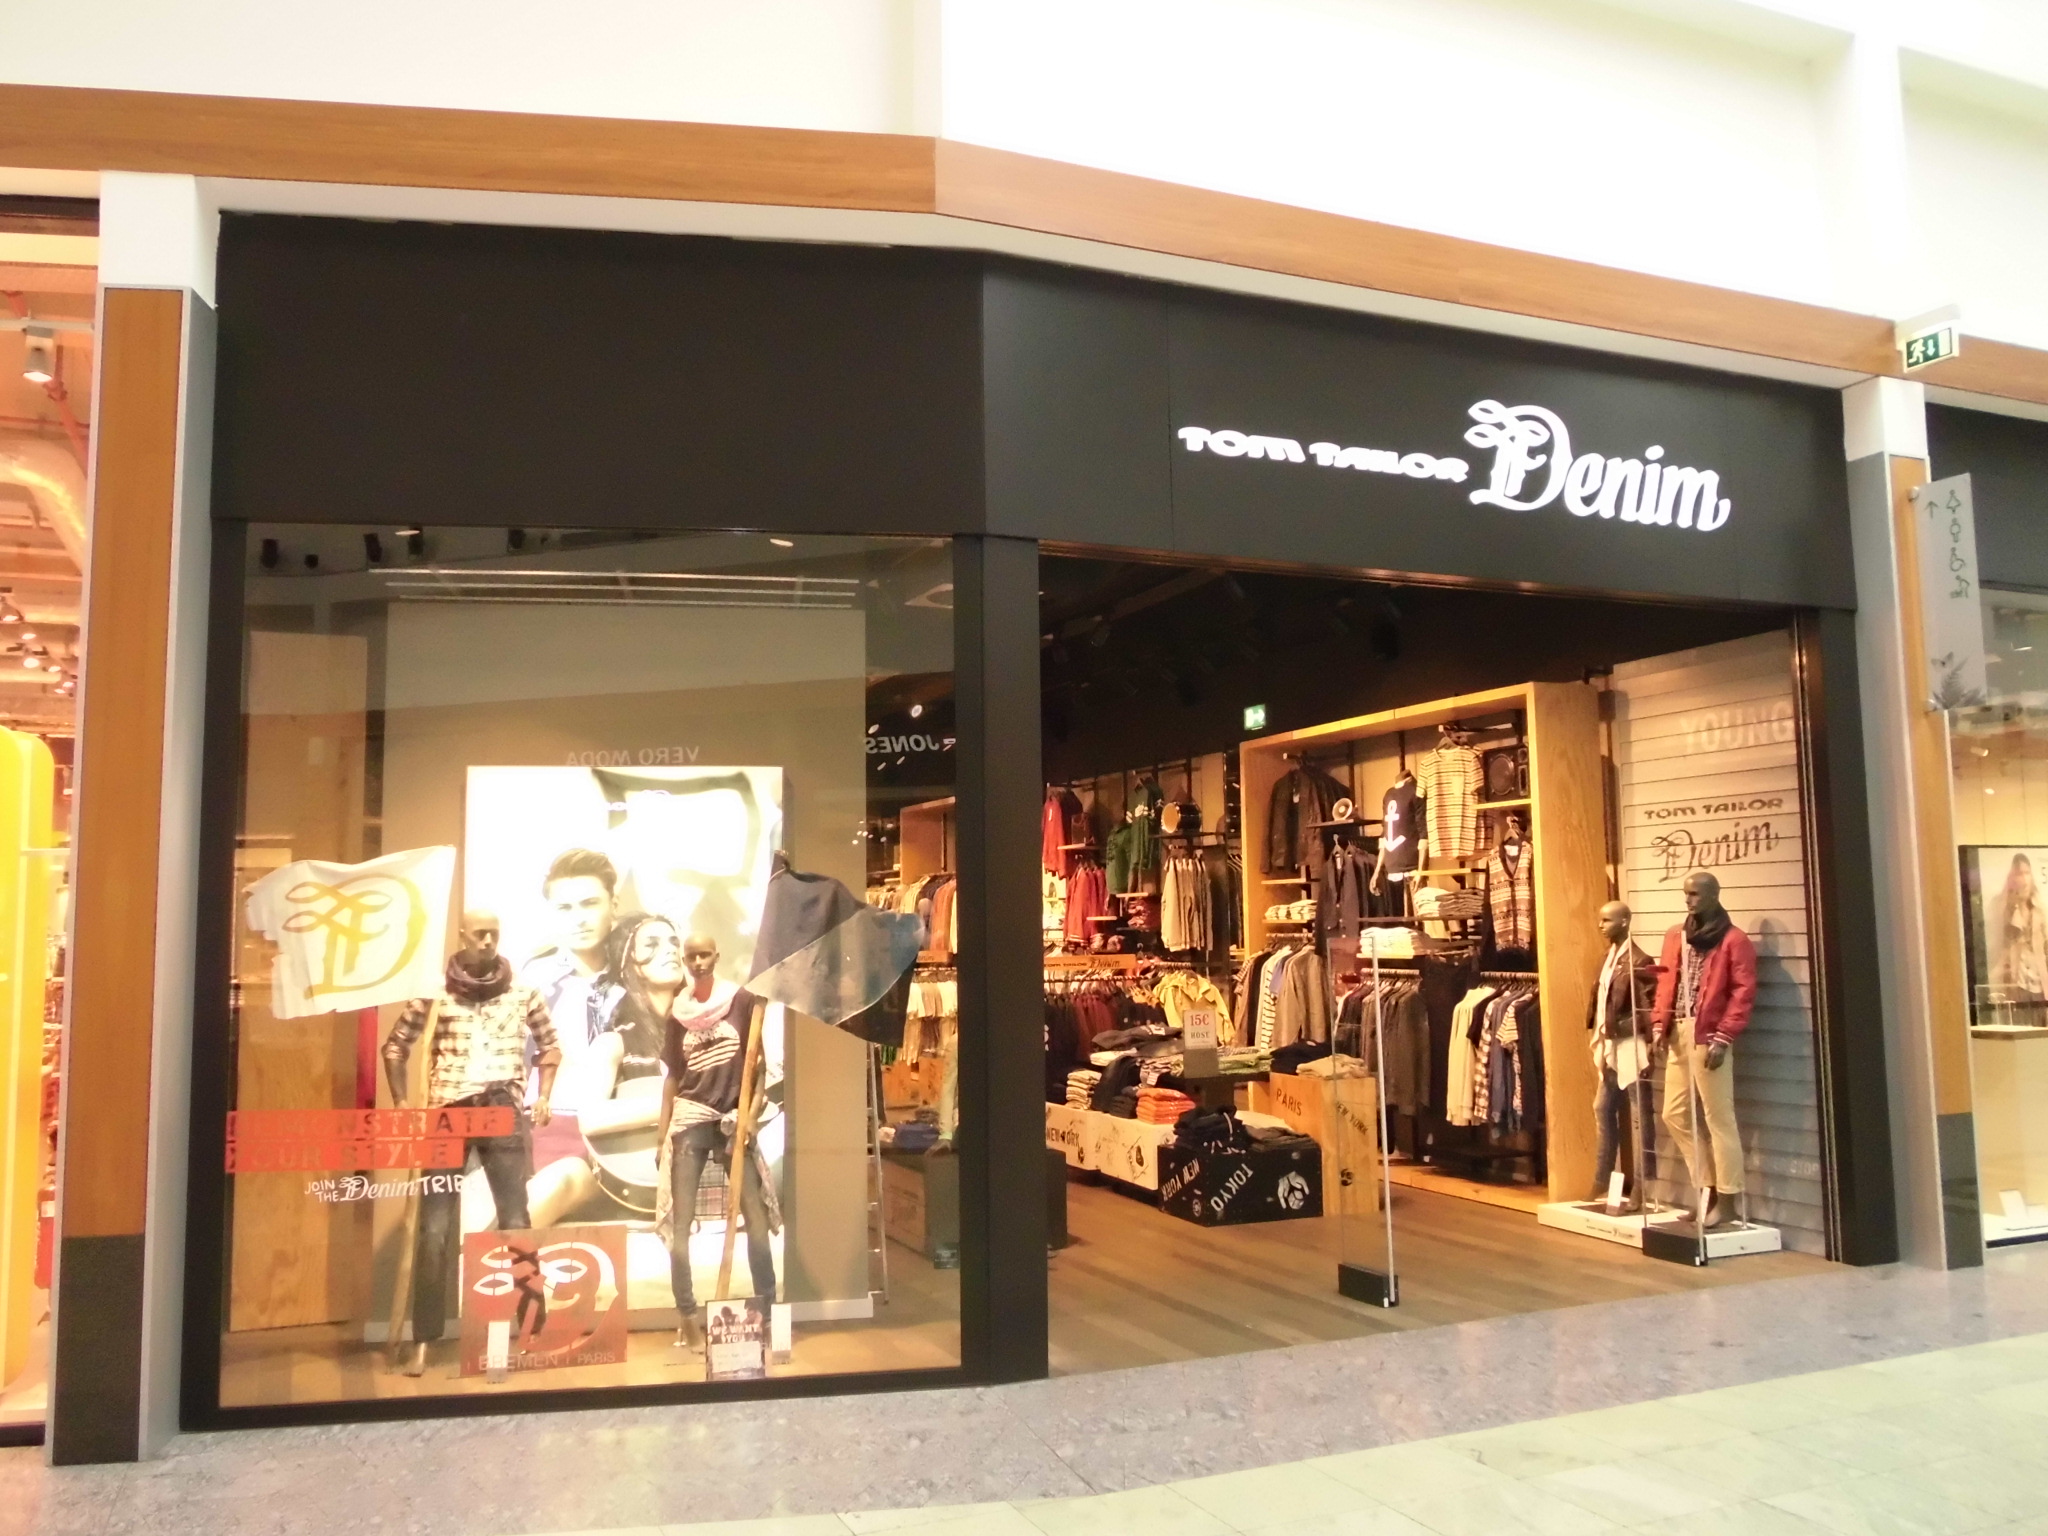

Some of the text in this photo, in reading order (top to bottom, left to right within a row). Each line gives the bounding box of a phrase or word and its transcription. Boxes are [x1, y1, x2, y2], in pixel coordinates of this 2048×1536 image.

[1177, 399, 1731, 532] TOM TAILOR Denim
[1644, 798, 1784, 820] TOM TAILOR
[1651, 821, 1780, 883] Denim
[1190, 1013, 1210, 1026] 15€
[1276, 1088, 1302, 1116] PARIS
[228, 1111, 498, 1138] EMONSTRATE
[228, 1142, 323, 1170] OUR
[1183, 1158, 1200, 1185] NEW
[304, 1174, 484, 1202] JOIN THE Denim TRIB
[1210, 1163, 1254, 1212] TOKYO
[577, 1351, 616, 1365] PARIS
